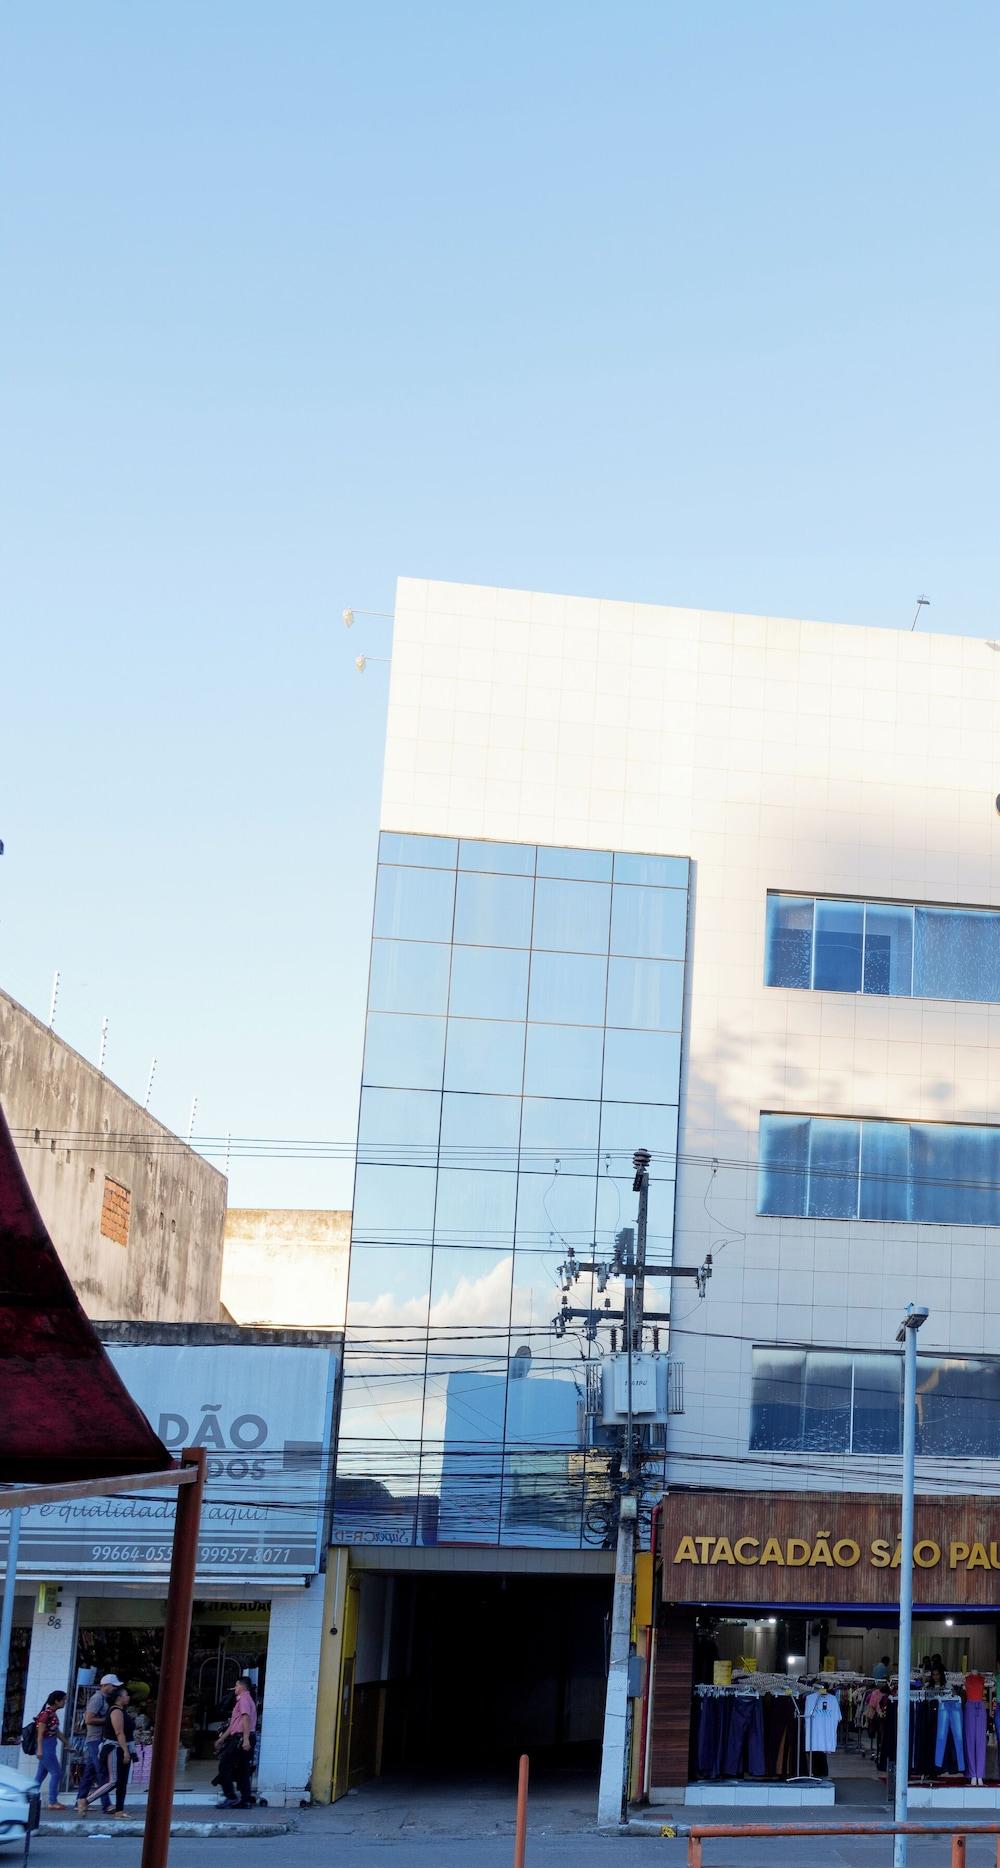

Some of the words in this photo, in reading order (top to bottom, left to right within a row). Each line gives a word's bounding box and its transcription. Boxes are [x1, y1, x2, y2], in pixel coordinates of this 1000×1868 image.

[91, 1546, 174, 1561] 99664-055
[673, 1530, 862, 1568] ATACADÃO
[47, 1615, 62, 1630] 88
